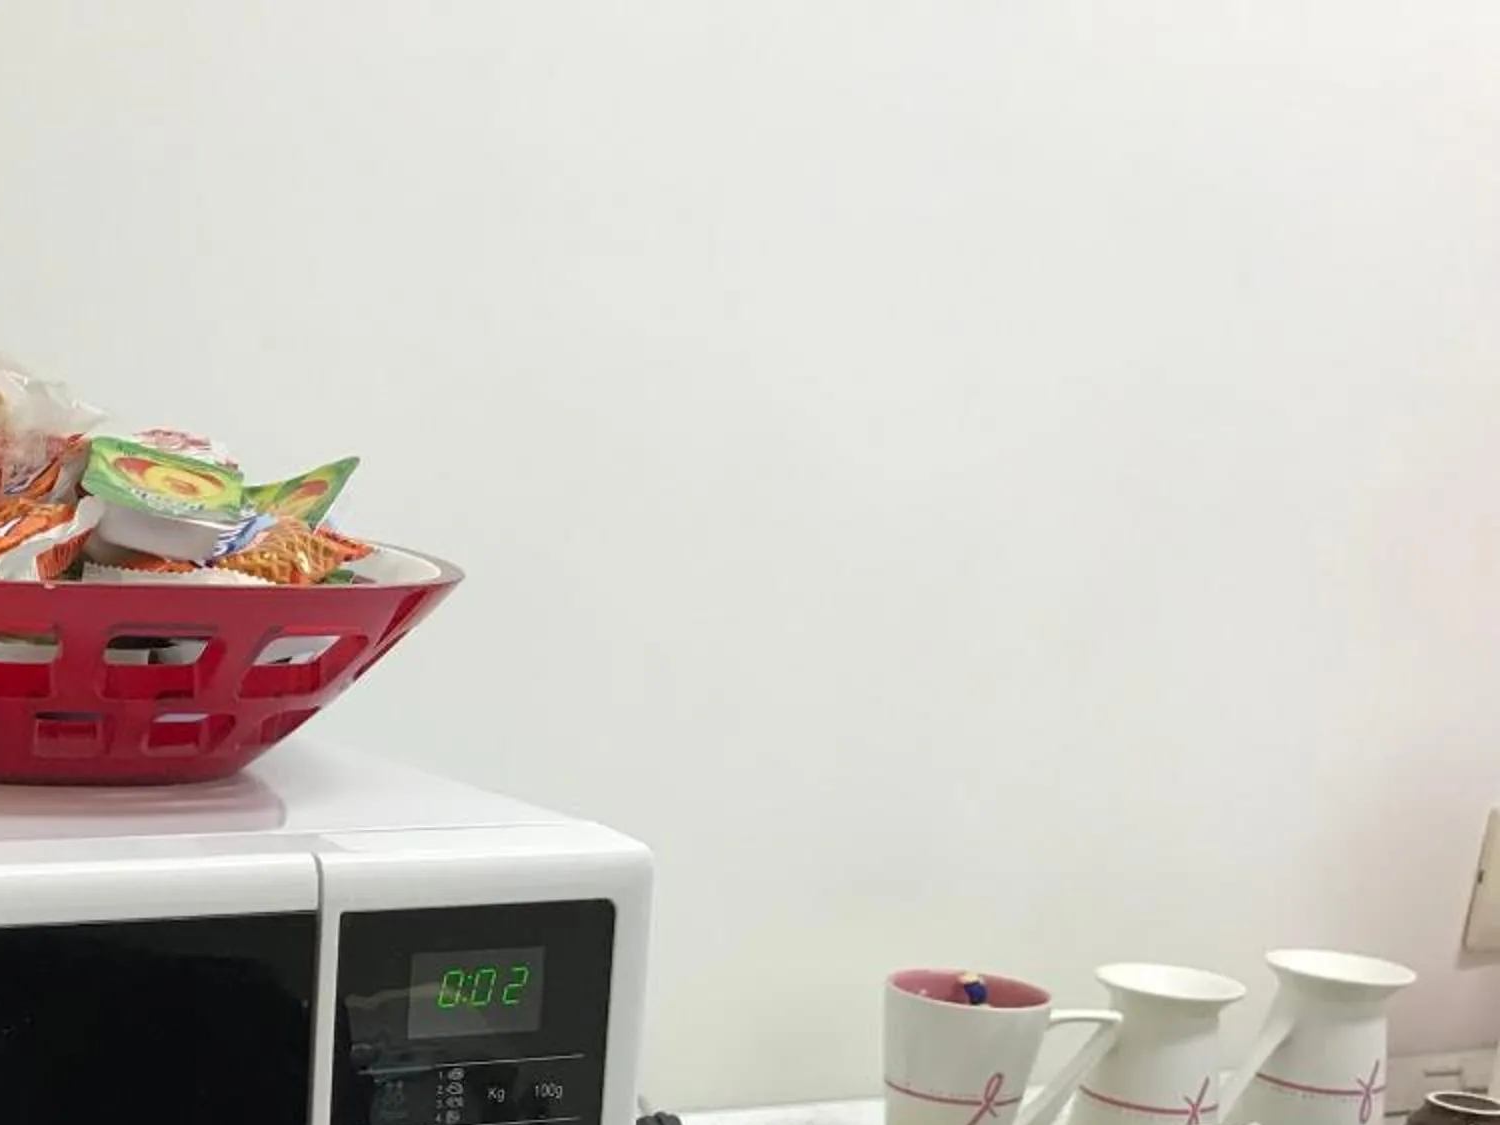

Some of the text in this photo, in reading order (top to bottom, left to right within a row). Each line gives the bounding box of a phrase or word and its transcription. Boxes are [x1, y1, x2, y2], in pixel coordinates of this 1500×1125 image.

[437, 966, 529, 1009] 0:02
[487, 1086, 506, 1103] Kg
[534, 1082, 564, 1100] 100g
